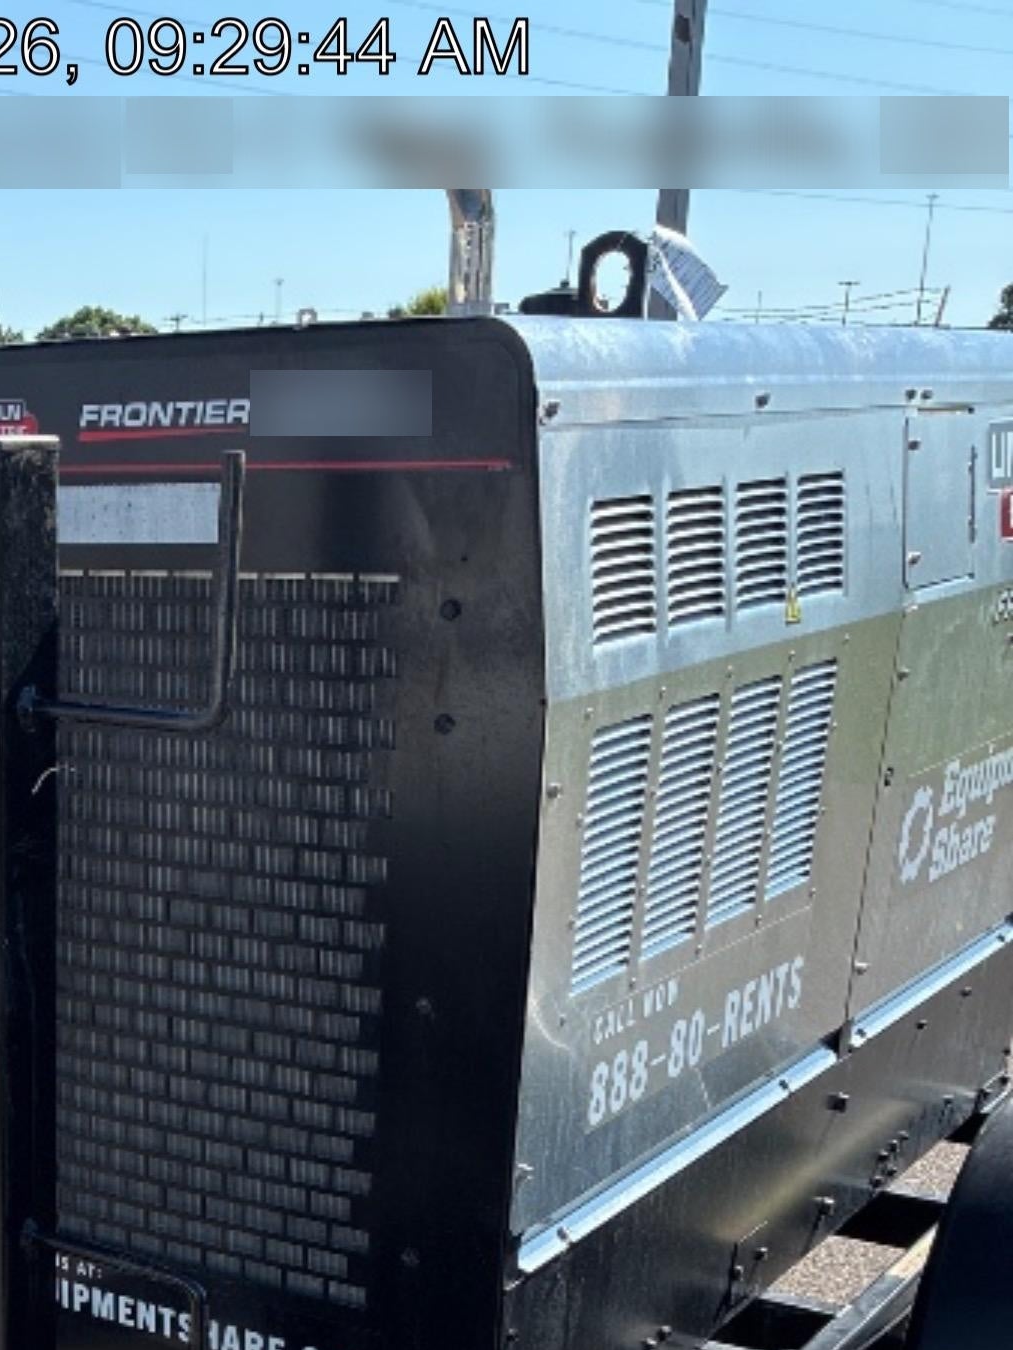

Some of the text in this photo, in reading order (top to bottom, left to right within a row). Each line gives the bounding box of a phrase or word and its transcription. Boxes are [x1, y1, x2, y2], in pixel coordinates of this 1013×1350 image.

[78, 399, 251, 428] FRONTIER
[929, 815, 996, 883] Share
[588, 956, 804, 1126] 888-80-RENTS
